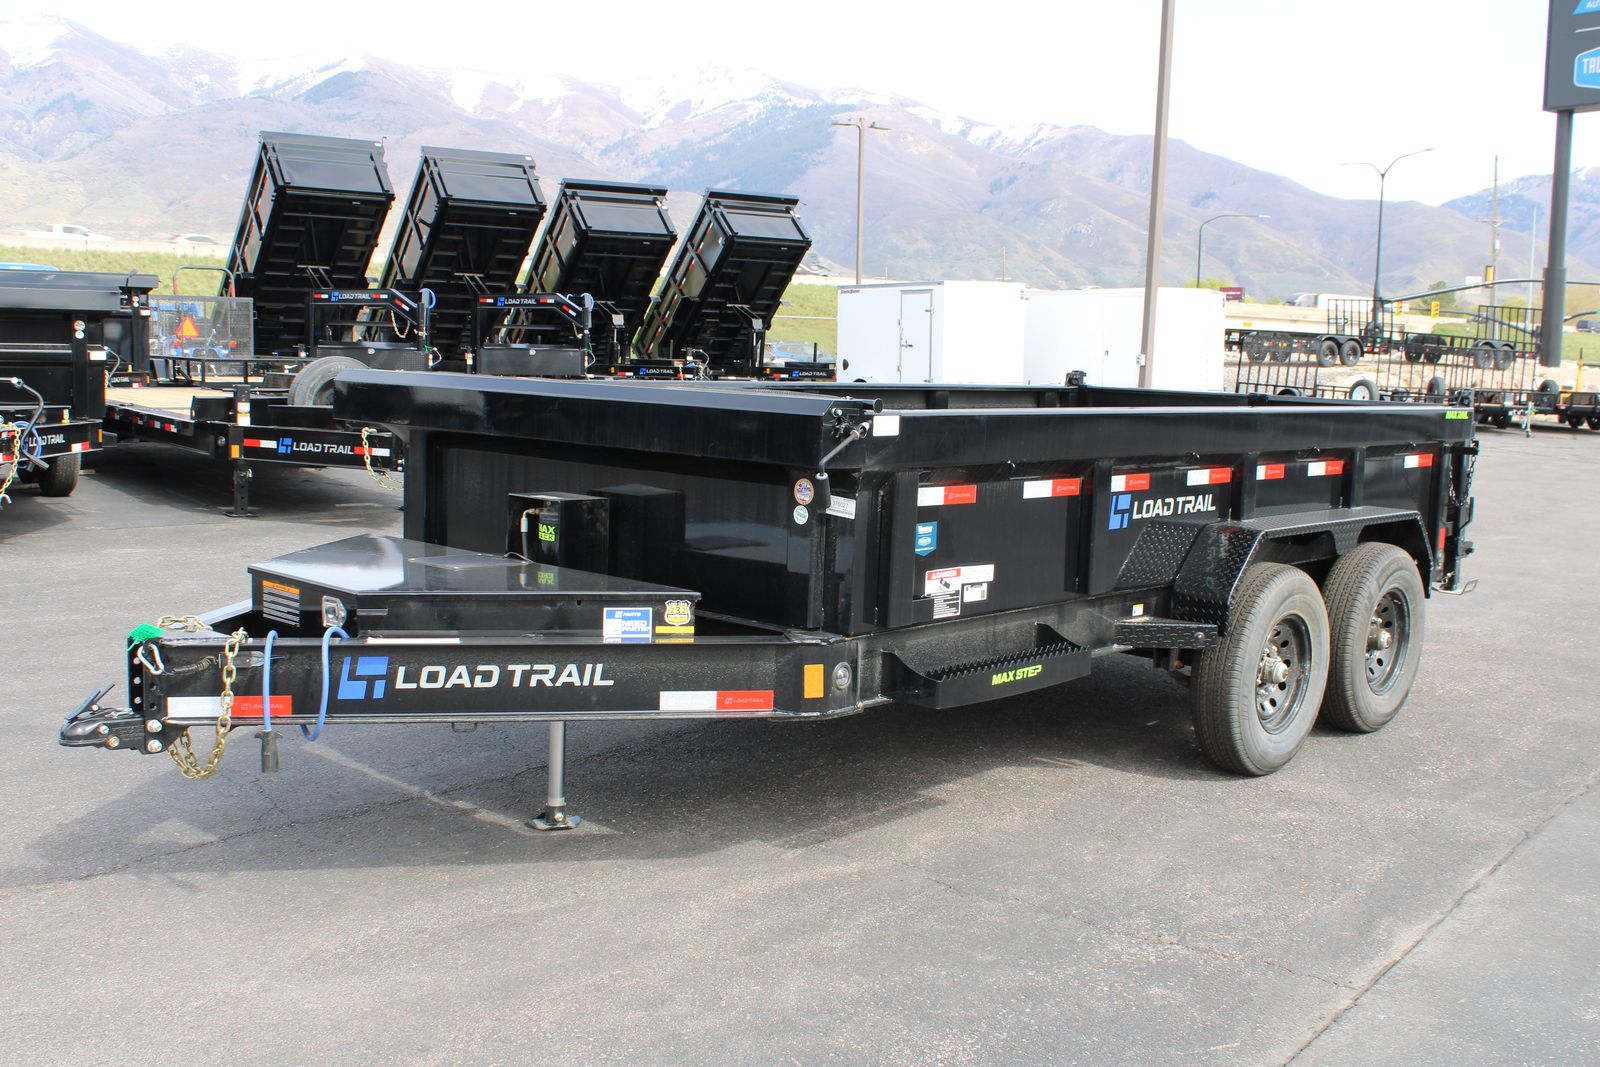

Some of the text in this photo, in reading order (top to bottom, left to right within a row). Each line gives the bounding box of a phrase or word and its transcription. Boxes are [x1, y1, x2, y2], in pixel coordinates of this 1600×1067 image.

[47, 433, 66, 445] TRAIL
[293, 442, 322, 452] LOAD
[323, 444, 354, 455] TRAIL
[1132, 498, 1175, 520] LOAD
[1176, 494, 1216, 515] TRAIL
[394, 664, 500, 689] LOAD
[507, 663, 615, 688] TRAIL
[991, 664, 1043, 686] MAX STEP
